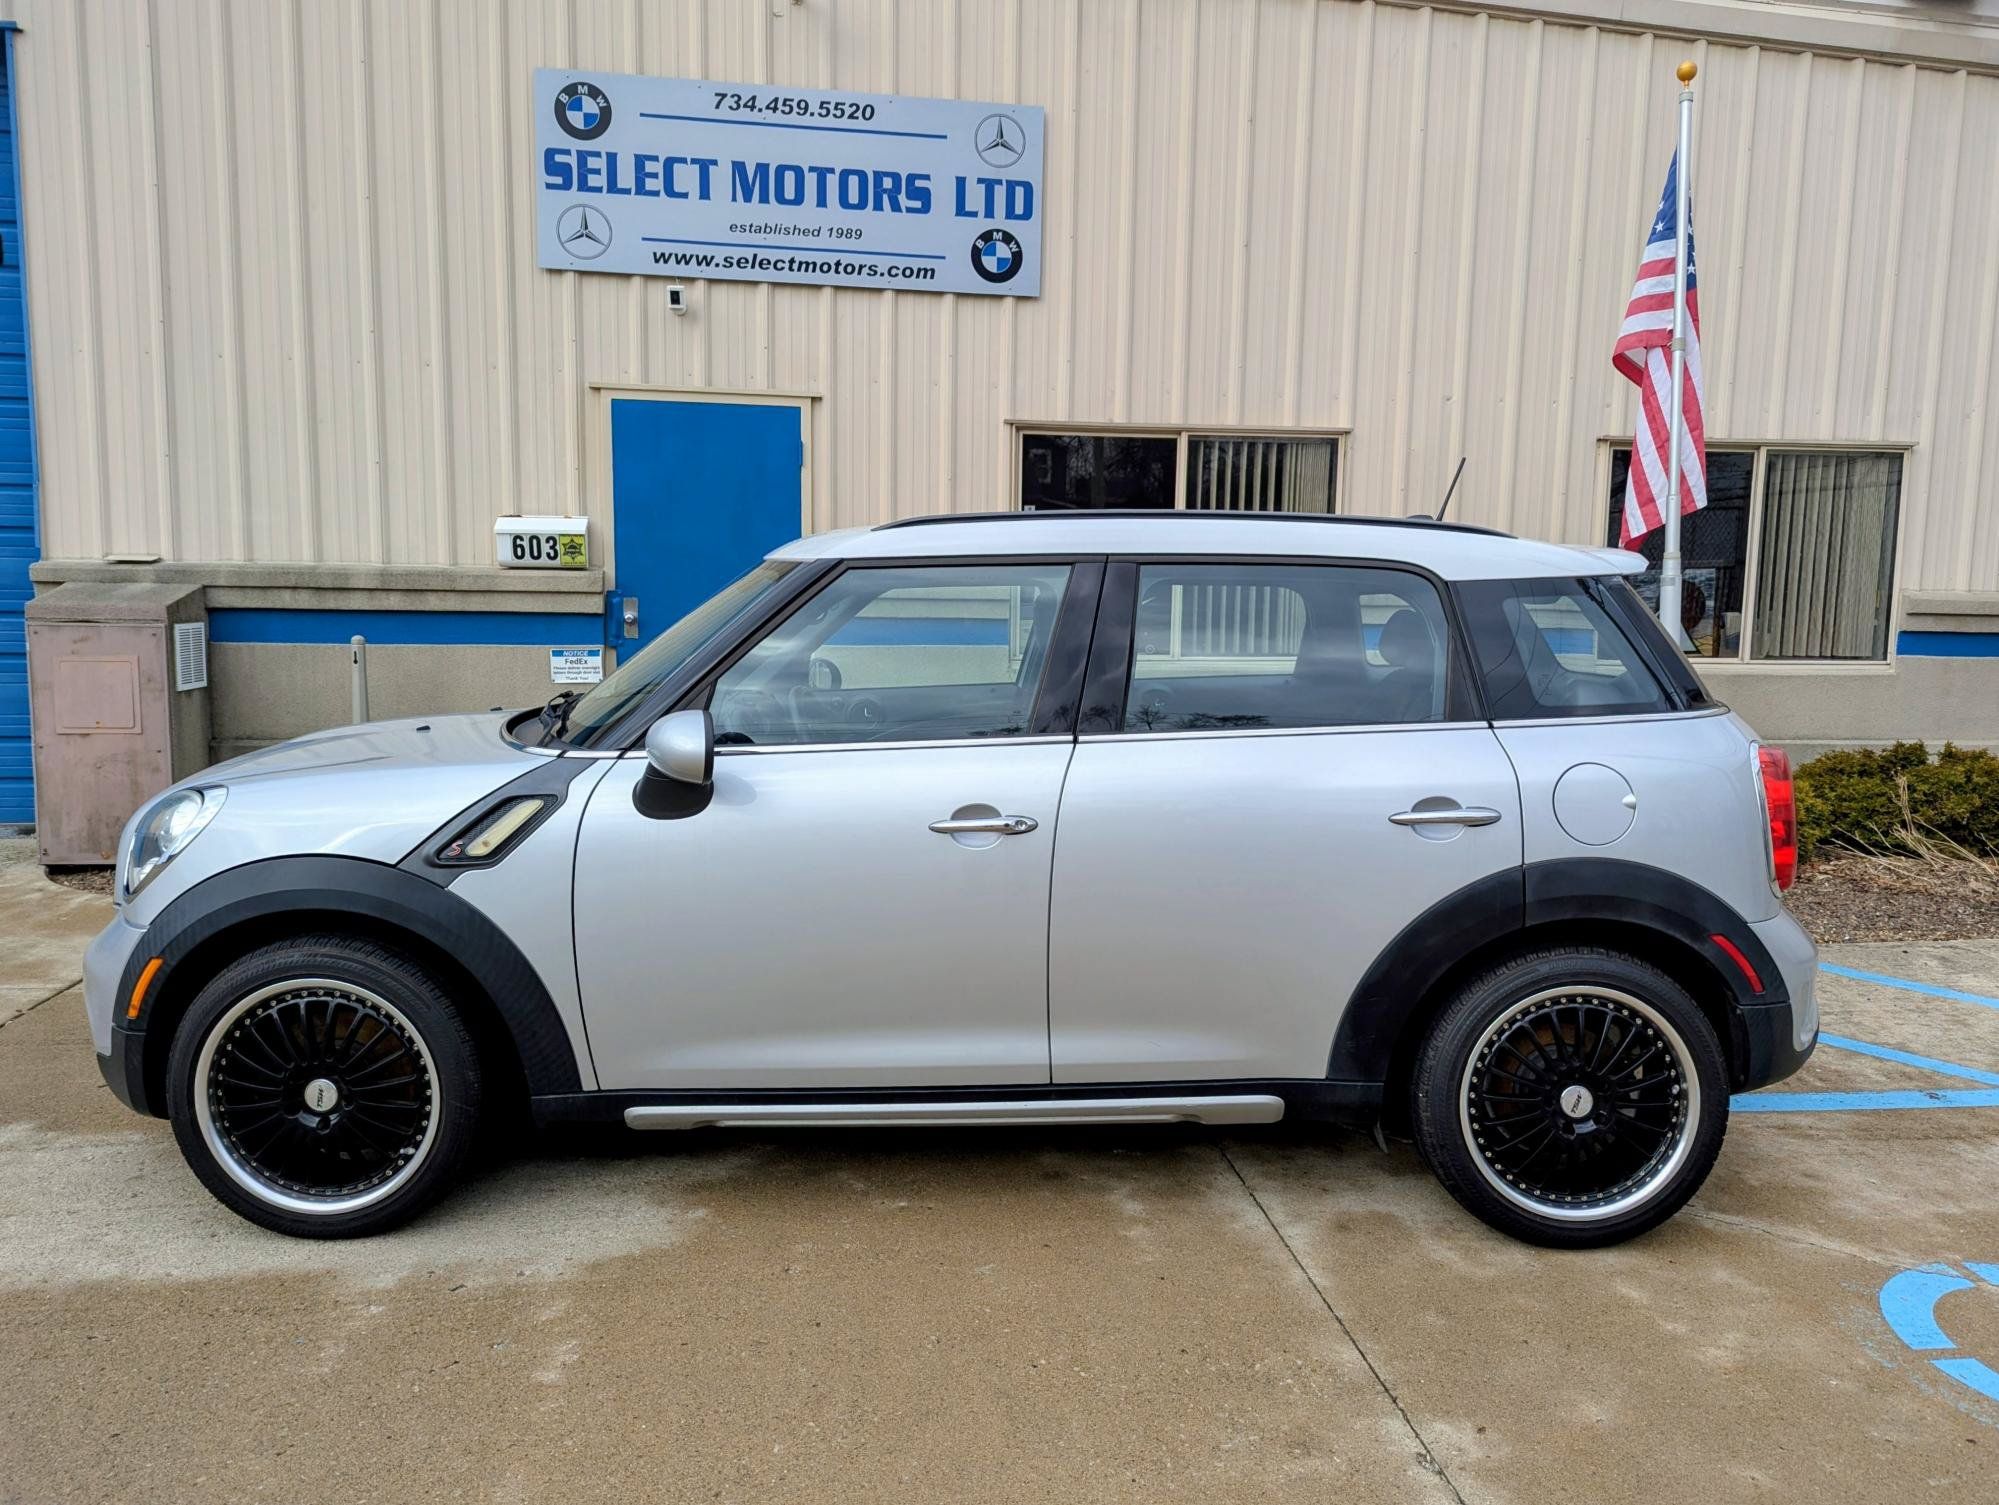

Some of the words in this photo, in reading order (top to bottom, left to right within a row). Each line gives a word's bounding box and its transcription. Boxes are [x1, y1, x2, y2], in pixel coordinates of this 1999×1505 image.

[558, 84, 608, 109] BMW
[713, 92, 875, 121] 734.459.5520
[543, 147, 719, 201] SELECT
[731, 160, 932, 215] MOTORS
[954, 175, 1034, 222] LTD
[729, 222, 821, 238] established
[827, 227, 863, 241] 1989
[975, 231, 1019, 253] BMW
[652, 251, 937, 280] www.selectmotors.com
[512, 535, 559, 561] 603
[447, 840, 463, 856] S
